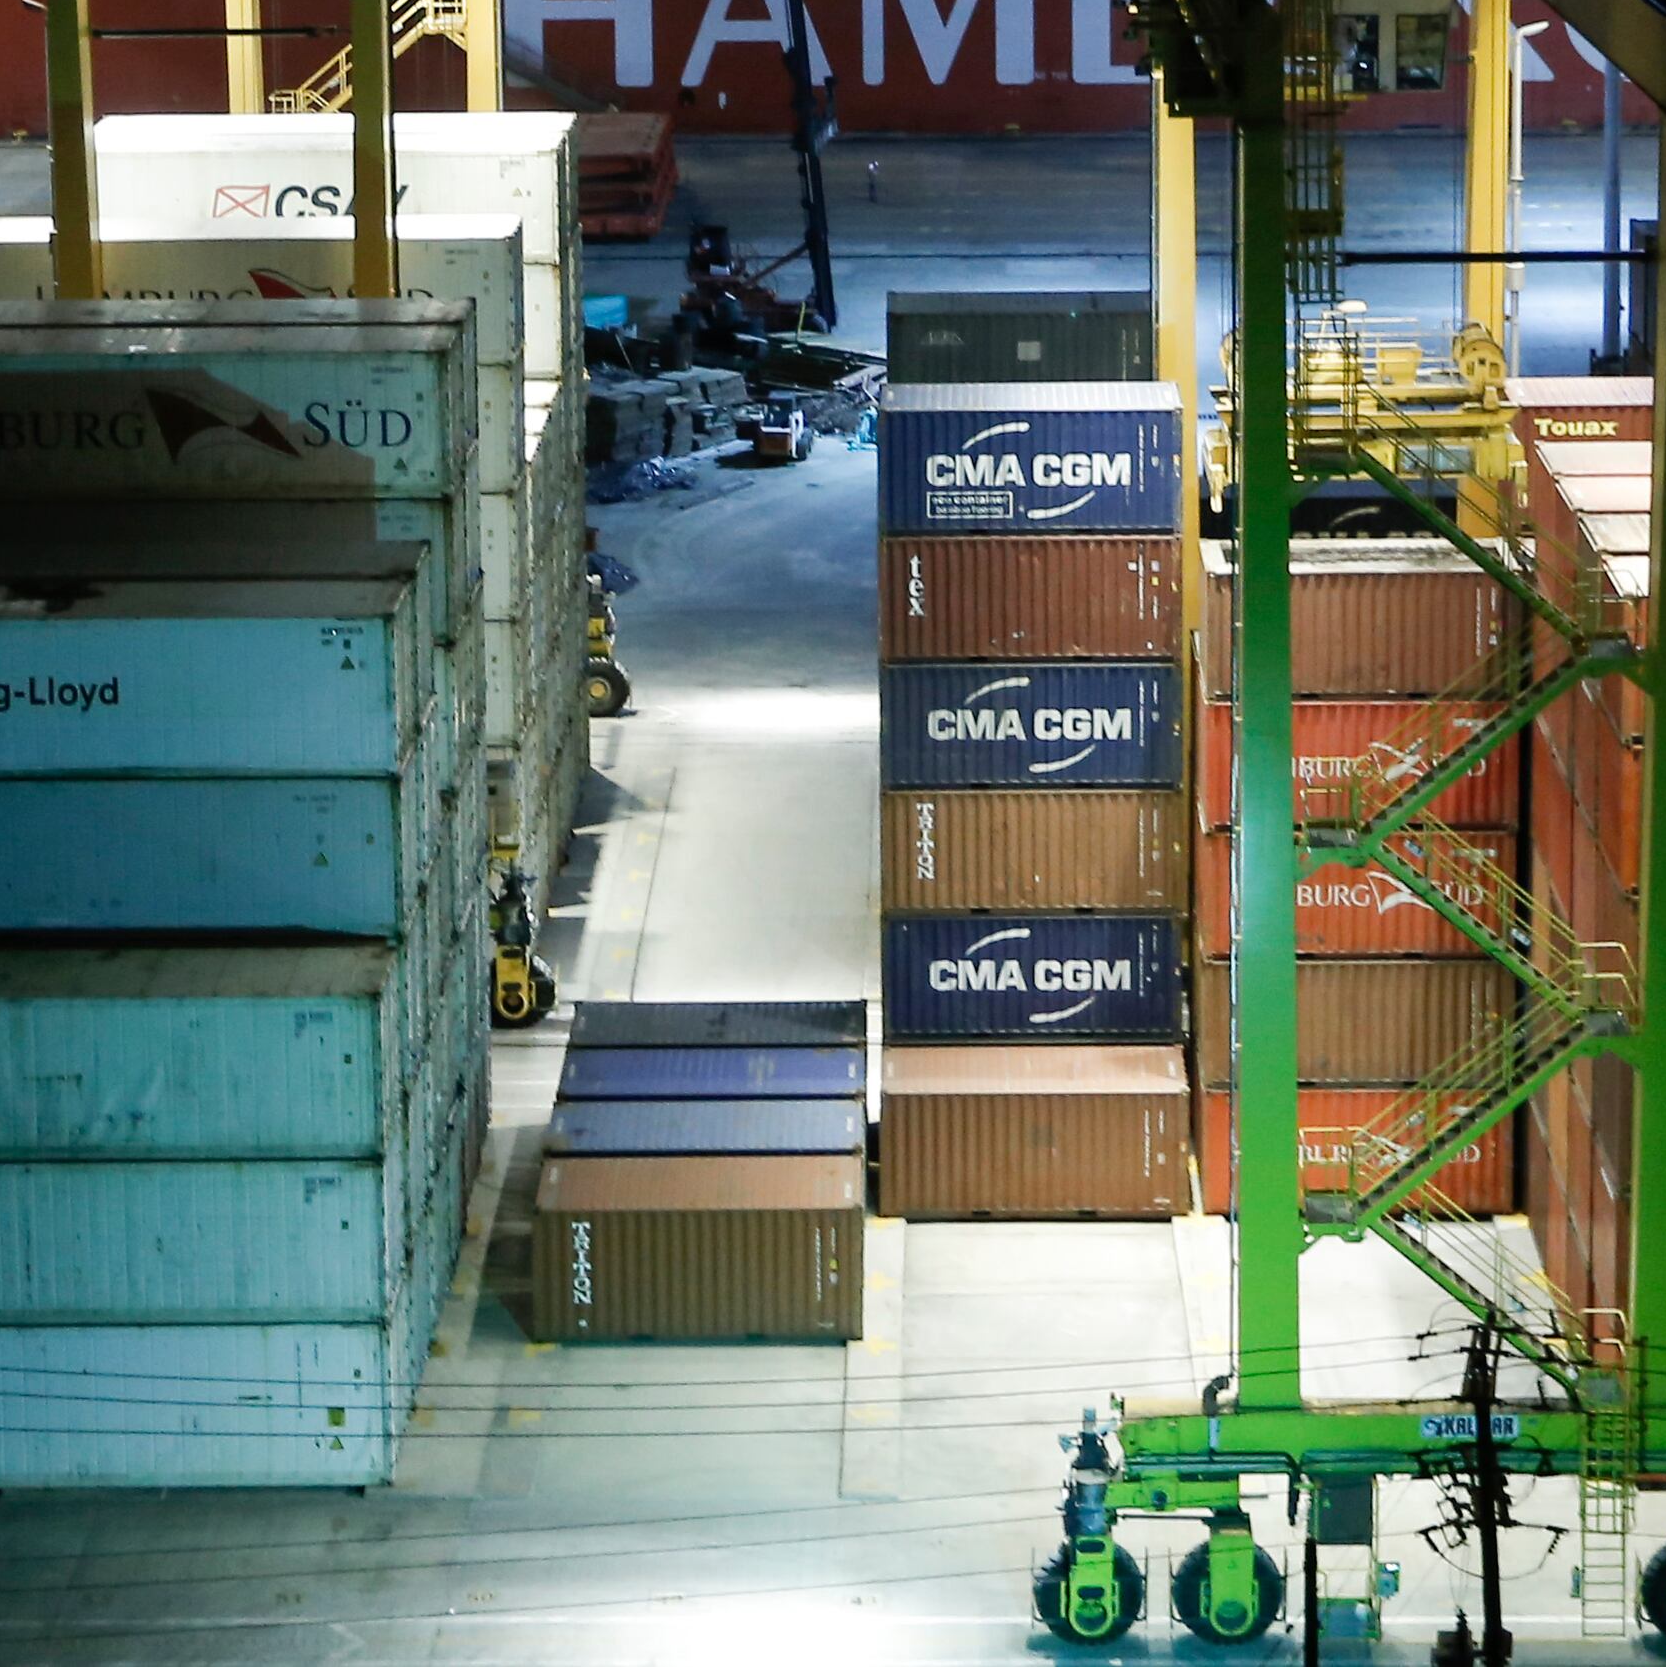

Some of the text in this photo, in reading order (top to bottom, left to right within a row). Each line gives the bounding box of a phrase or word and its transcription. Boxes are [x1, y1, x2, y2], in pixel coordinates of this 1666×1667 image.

[302, 401, 411, 447] SÜD
[1534, 417, 1619, 438] Touax
[926, 453, 1025, 488] CMA
[1032, 453, 1131, 488] CGM
[928, 708, 1132, 743] CMA CGM
[916, 803, 935, 880] TRITON
[1296, 884, 1370, 908] BURG
[929, 958, 1132, 992] CMA CGM
[572, 1222, 592, 1306] TRITON
[1444, 1417, 1514, 1436] KALAR
